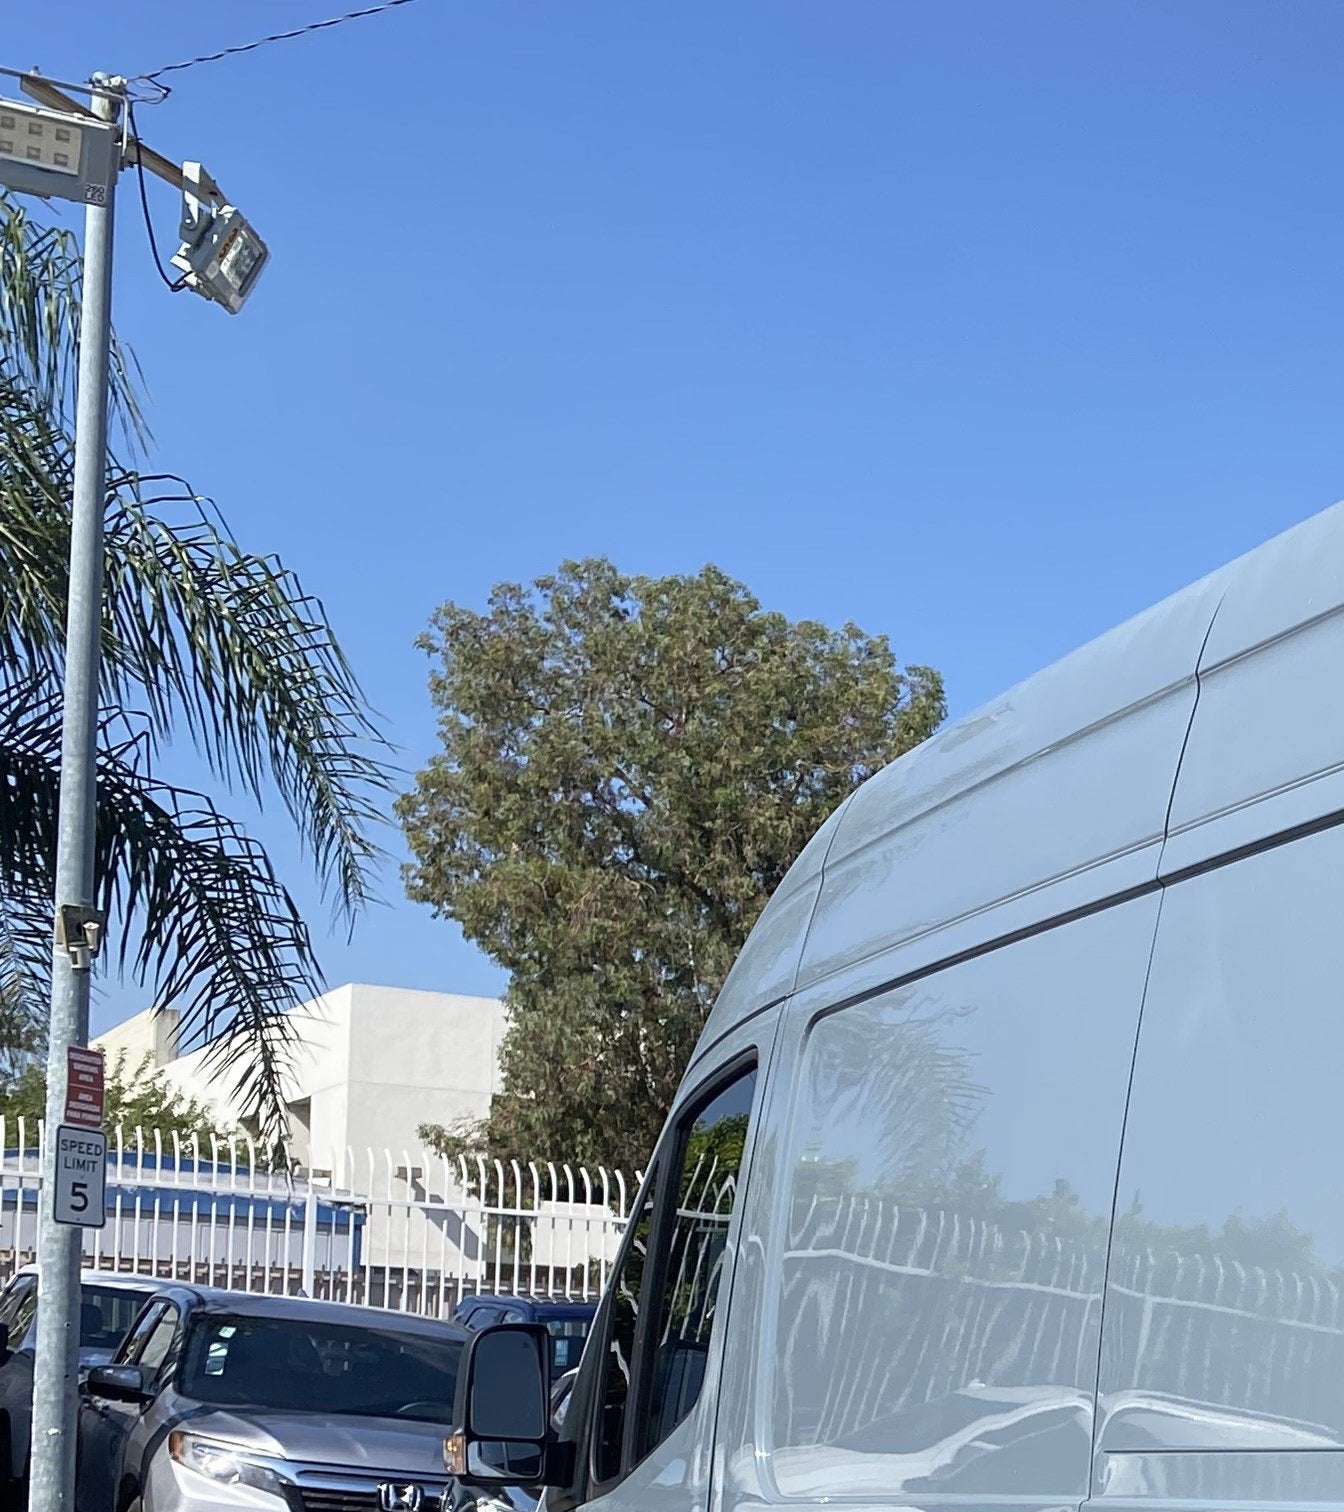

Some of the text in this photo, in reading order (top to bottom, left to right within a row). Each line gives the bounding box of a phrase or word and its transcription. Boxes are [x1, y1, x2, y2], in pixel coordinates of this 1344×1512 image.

[60, 1138, 103, 1157] SPEED
[63, 1156, 98, 1173] LIMIT
[70, 1181, 88, 1212] 5
